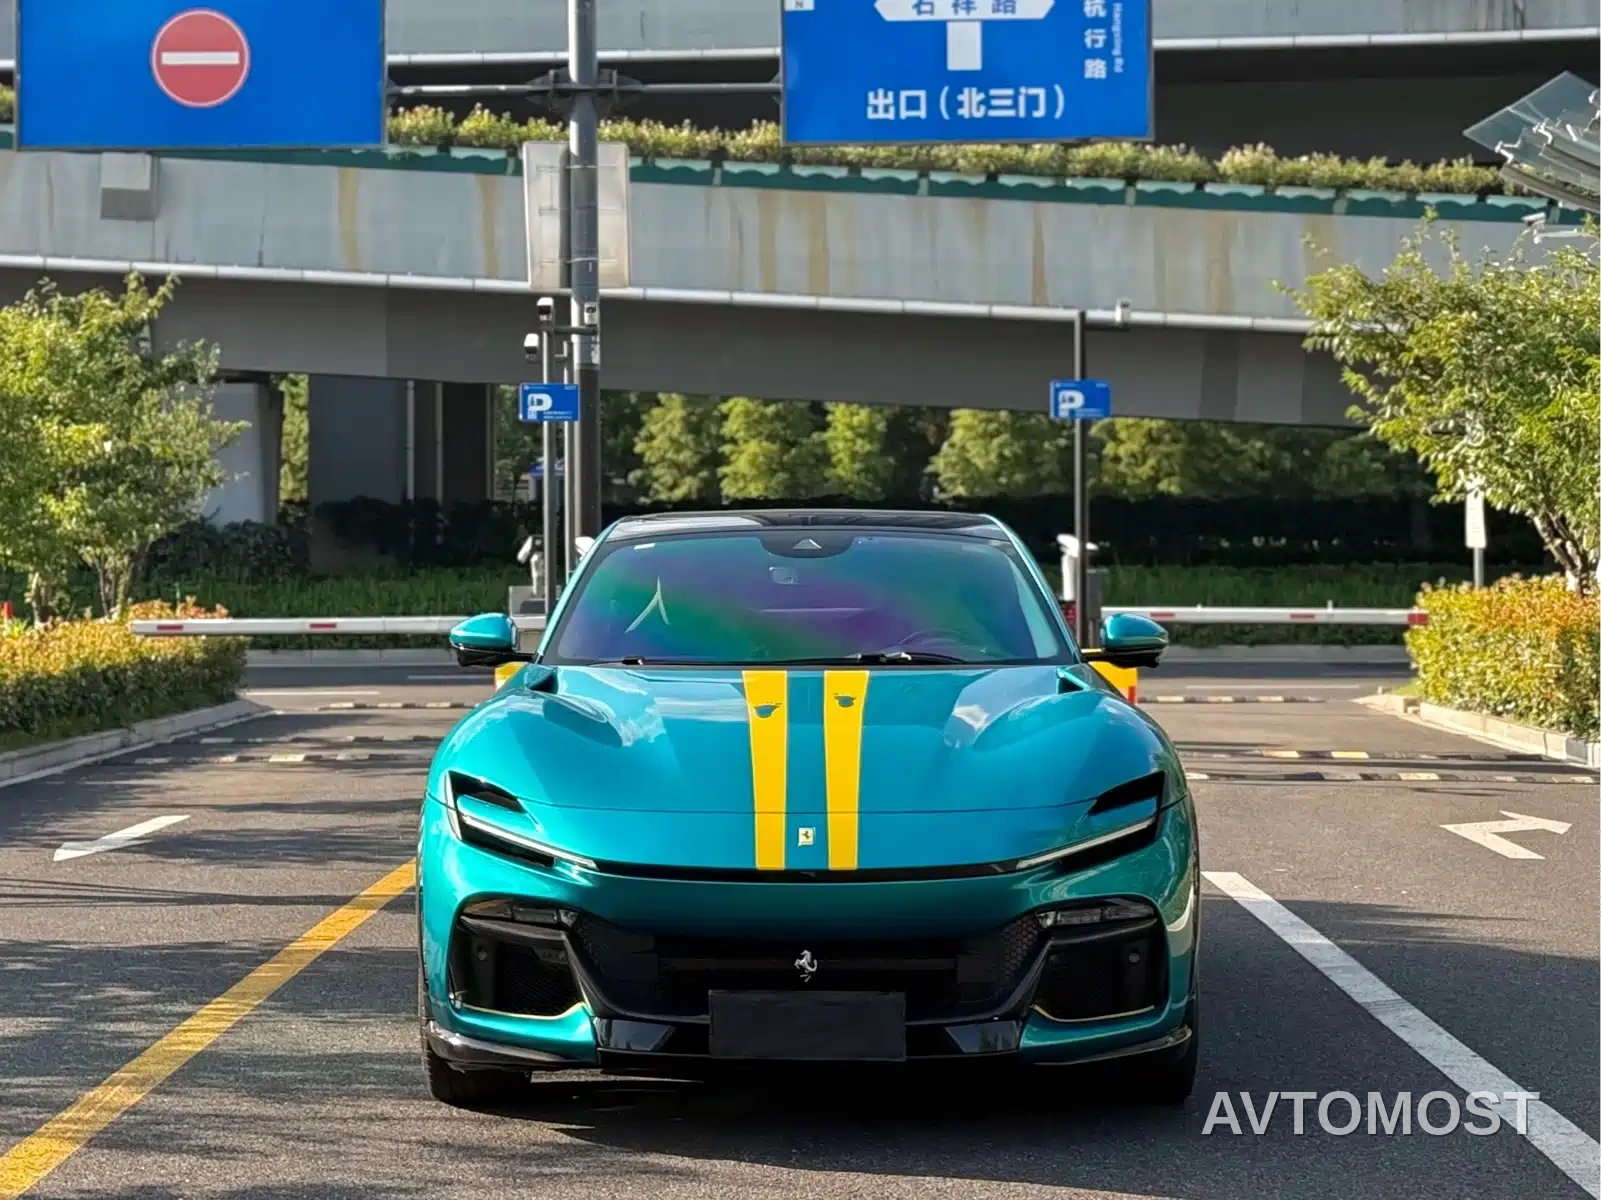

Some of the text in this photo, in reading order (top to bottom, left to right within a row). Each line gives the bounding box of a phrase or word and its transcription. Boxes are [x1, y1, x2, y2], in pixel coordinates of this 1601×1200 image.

[912, 0, 1017, 15] 石祥路
[1083, 0, 1107, 79] 杭行路
[527, 393, 553, 419] P
